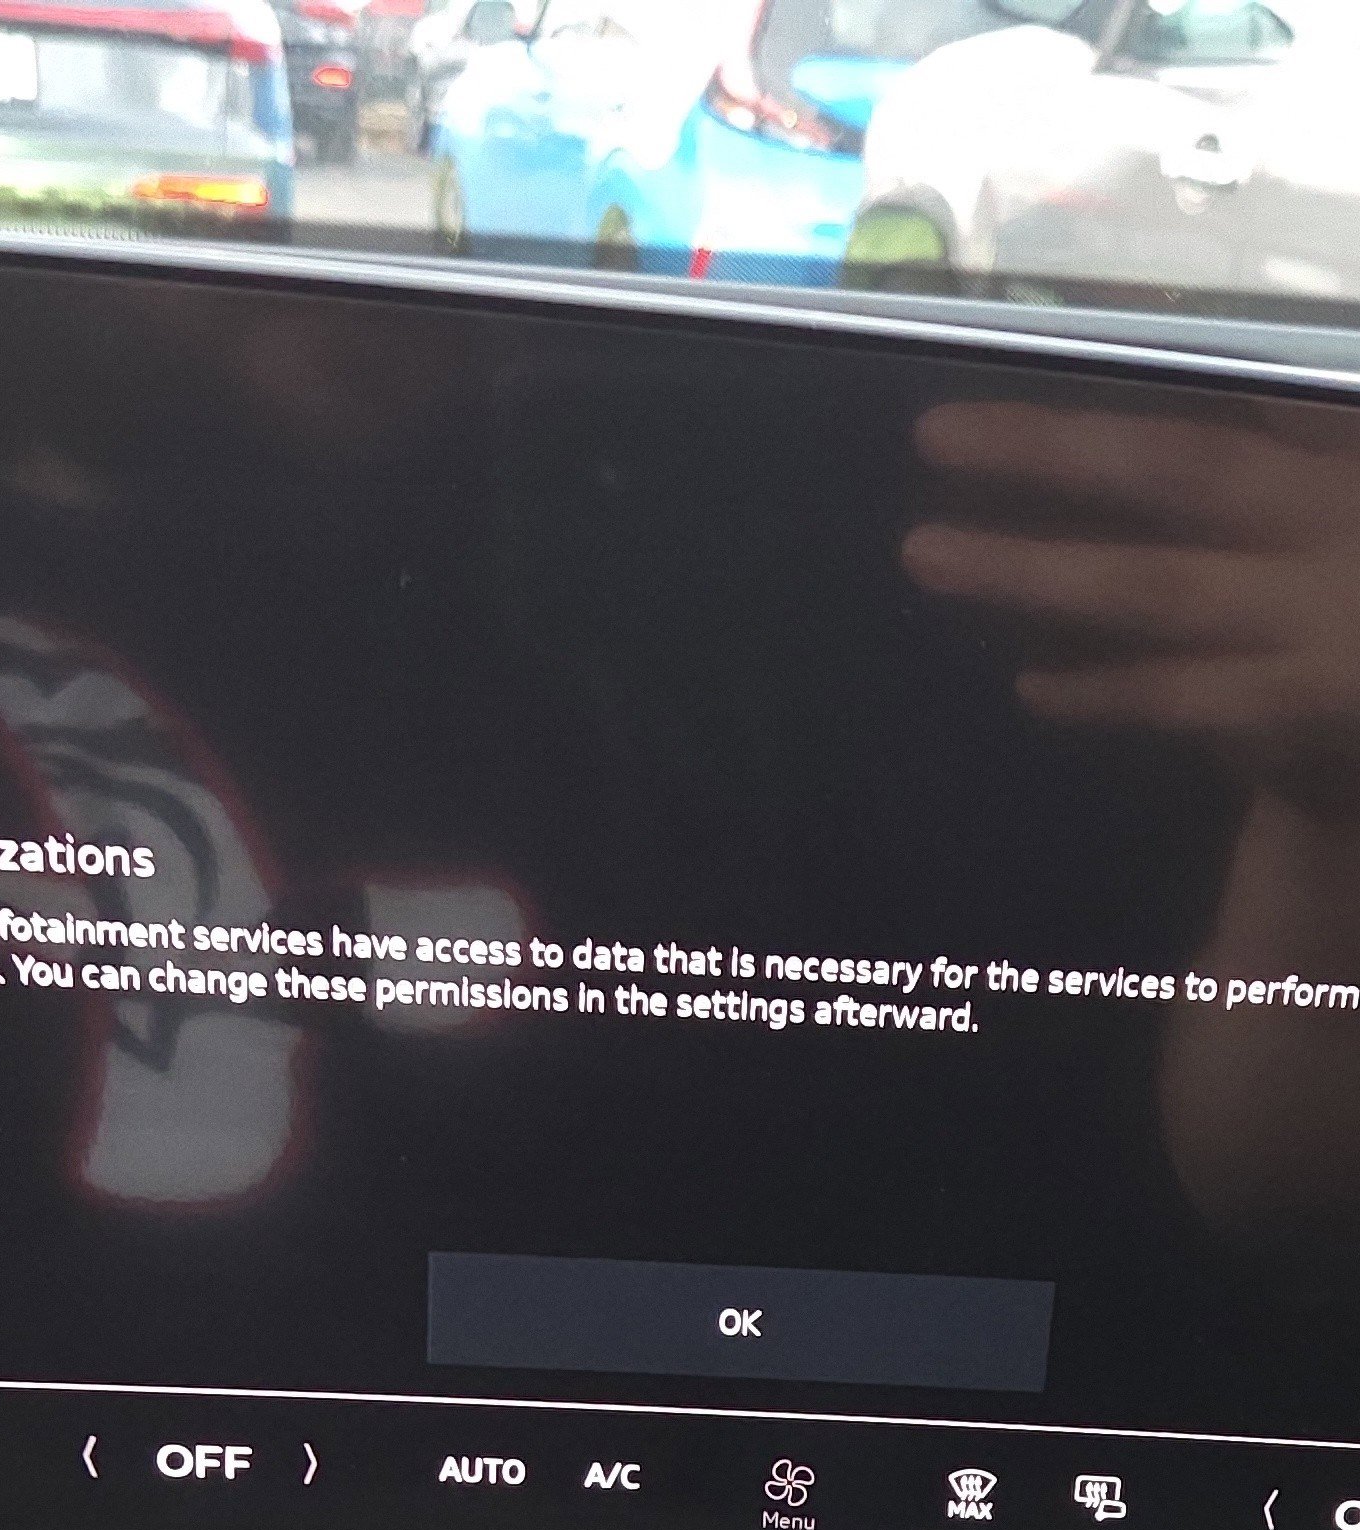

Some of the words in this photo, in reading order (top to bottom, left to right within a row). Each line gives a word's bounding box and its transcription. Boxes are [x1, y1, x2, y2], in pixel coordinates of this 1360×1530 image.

[193, 921, 324, 957] services
[332, 925, 407, 961] have
[415, 936, 522, 967] access
[530, 938, 564, 968] to
[573, 937, 645, 973] data
[653, 942, 723, 977] that
[731, 946, 756, 978] is
[765, 956, 923, 994] necessary
[930, 956, 979, 989] for
[986, 960, 1040, 993] the
[1048, 966, 1176, 1000] services
[1184, 972, 1218, 1002] to
[1225, 975, 1360, 1011] perform
[12, 952, 74, 991] You
[81, 964, 141, 991] can
[148, 960, 268, 1003] change
[275, 967, 367, 1003] these
[375, 975, 569, 1012] permissions
[578, 981, 605, 1014] in
[614, 983, 668, 1017] the
[676, 989, 805, 1030] settings
[814, 994, 979, 1033] afterward.
[718, 1308, 763, 1337] OK
[156, 1444, 253, 1480] OFF
[438, 1455, 526, 1485] AUTO
[583, 1461, 641, 1490] A/C
[762, 1510, 816, 1530] Menu
[947, 1497, 994, 1520] MAX
